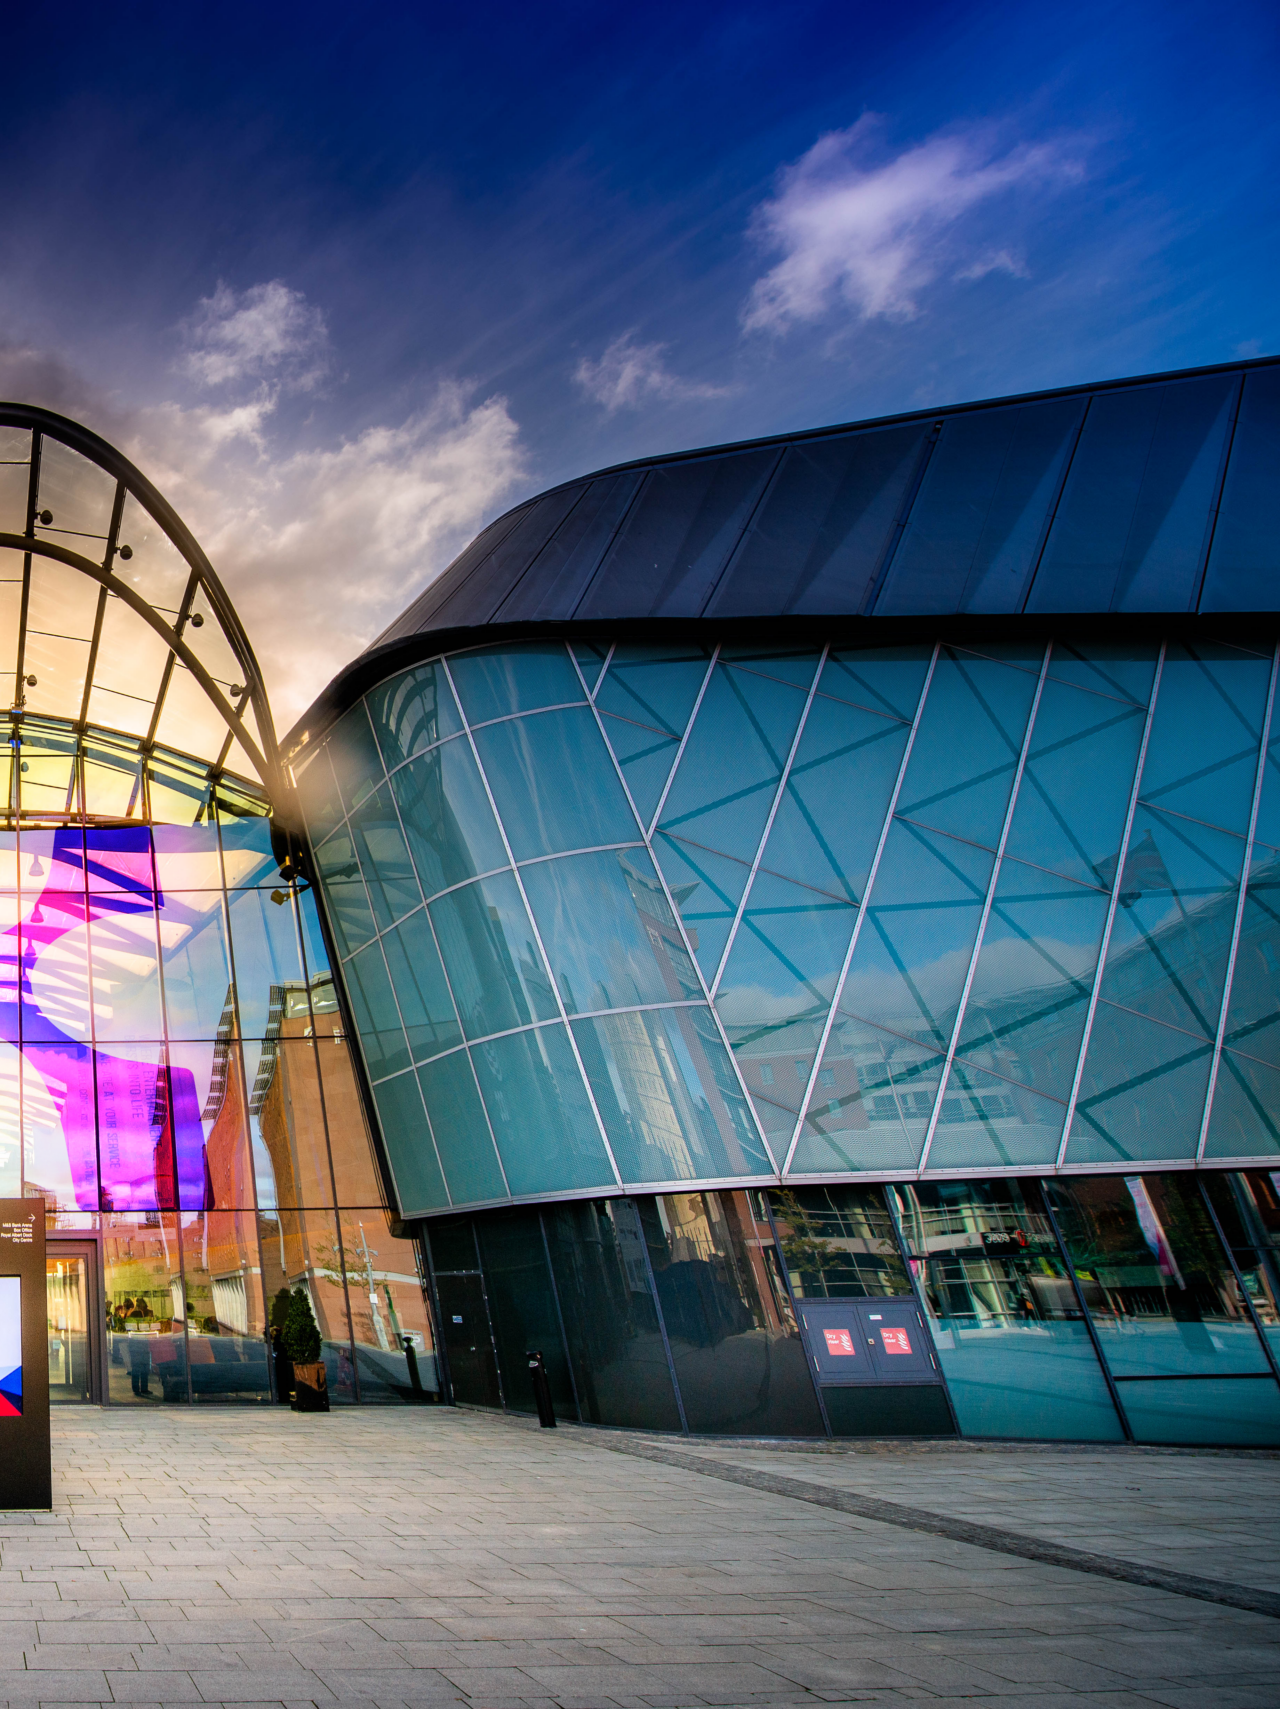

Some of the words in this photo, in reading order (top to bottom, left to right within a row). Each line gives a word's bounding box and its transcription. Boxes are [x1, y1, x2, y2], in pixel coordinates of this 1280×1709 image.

[128, 1074, 141, 1095] INTO
[104, 1090, 114, 1101] AT
[105, 1106, 117, 1129] YOUR
[130, 1099, 144, 1119] LIFE
[107, 1132, 120, 1169] SERVICE
